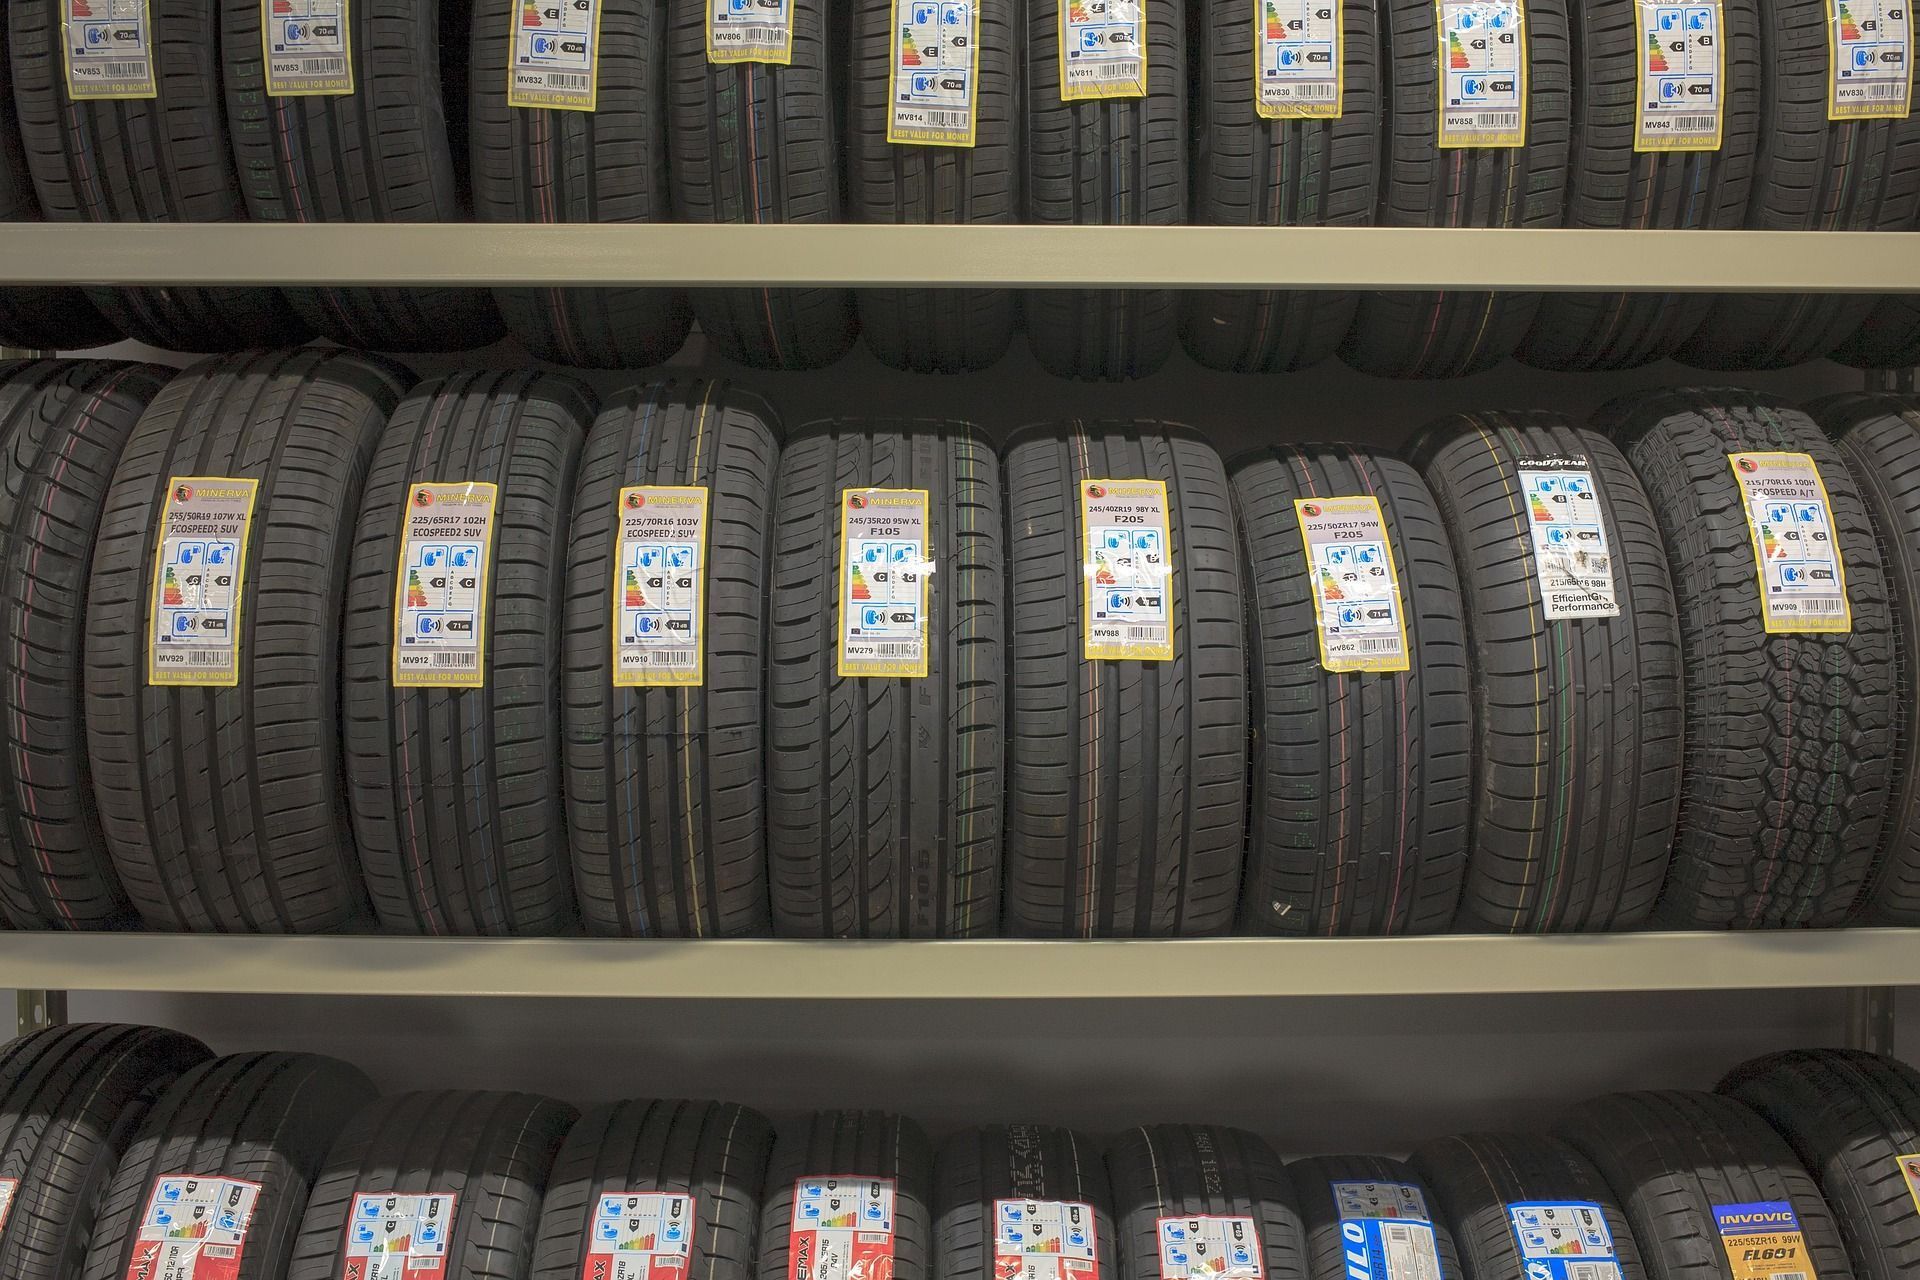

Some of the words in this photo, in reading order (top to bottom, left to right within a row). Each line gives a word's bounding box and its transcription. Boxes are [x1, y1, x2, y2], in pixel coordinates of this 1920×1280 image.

[273, 64, 299, 72] MV853
[518, 76, 542, 84] MV832
[1520, 459, 1586, 467] GOODYEAR
[196, 489, 249, 497] MINERVA
[1800, 489, 1815, 497] A/T
[436, 494, 490, 503] MINERVA
[647, 496, 702, 504] MINERVA
[169, 512, 210, 521] 255/50R19
[213, 512, 235, 520] 107W
[236, 513, 246, 521] XL
[412, 517, 460, 525] 225/65R17
[463, 517, 486, 525] 102H
[626, 518, 673, 526] 225/70R16
[171, 524, 217, 534] ECOSPEED2
[220, 525, 238, 534] SUV
[1308, 521, 1359, 531] 225/50ZR17
[413, 528, 460, 537] ECOSPEED2
[463, 529, 481, 537] SUV
[627, 529, 675, 538] ECOSPEED2
[870, 528, 900, 536] F105
[1334, 531, 1363, 539] F205
[1552, 602, 1614, 612] Performance
[1720, 1212, 1792, 1224] INVOVIC
[1728, 1237, 1777, 1247] 225/55ZR16
[1782, 1235, 1800, 1244] 99W
[1743, 1247, 1796, 1261] EL601
